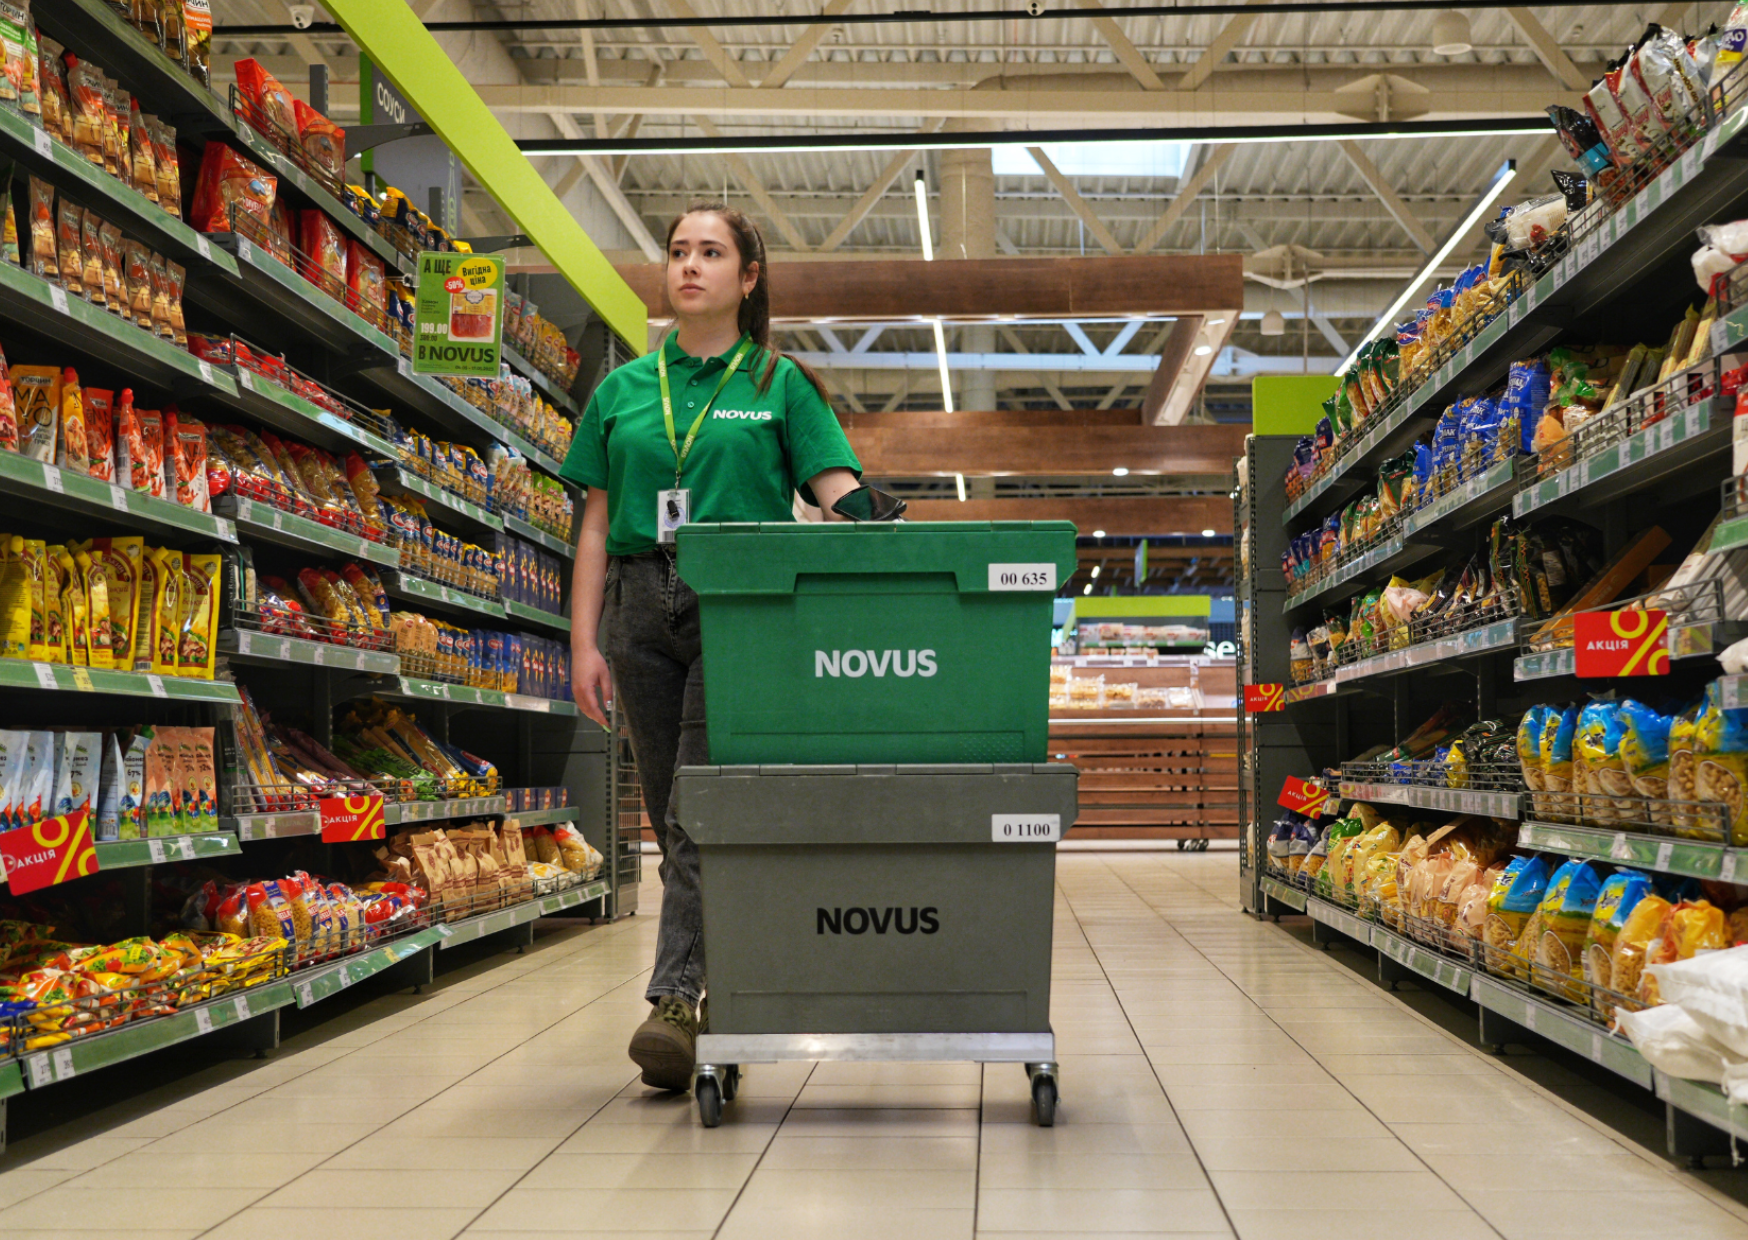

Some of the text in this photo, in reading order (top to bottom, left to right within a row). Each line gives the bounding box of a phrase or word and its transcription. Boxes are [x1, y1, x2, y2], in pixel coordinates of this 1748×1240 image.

[377, 82, 405, 124] СОУСИ
[424, 259, 451, 275] А ЩЕ
[462, 265, 491, 277] Вигідна
[445, 280, 464, 290] -50%
[469, 276, 486, 286] ціна
[420, 322, 448, 335] 199.00
[418, 345, 494, 363] В NOVUS
[713, 410, 772, 420] NOVUS
[681, 435, 694, 458] NOVUS
[1000, 573, 1048, 586] 00 635
[1586, 640, 1629, 651] АКЦІЯ
[815, 649, 938, 678] NOVUS
[127, 769, 141, 777] 67%
[1287, 791, 1308, 802] АКЦІЯ
[329, 814, 357, 823] АКЦІЯ
[1003, 824, 1051, 836] 0 1100
[17, 849, 56, 869] АКЦІЯ
[816, 907, 940, 935] NOVUS
